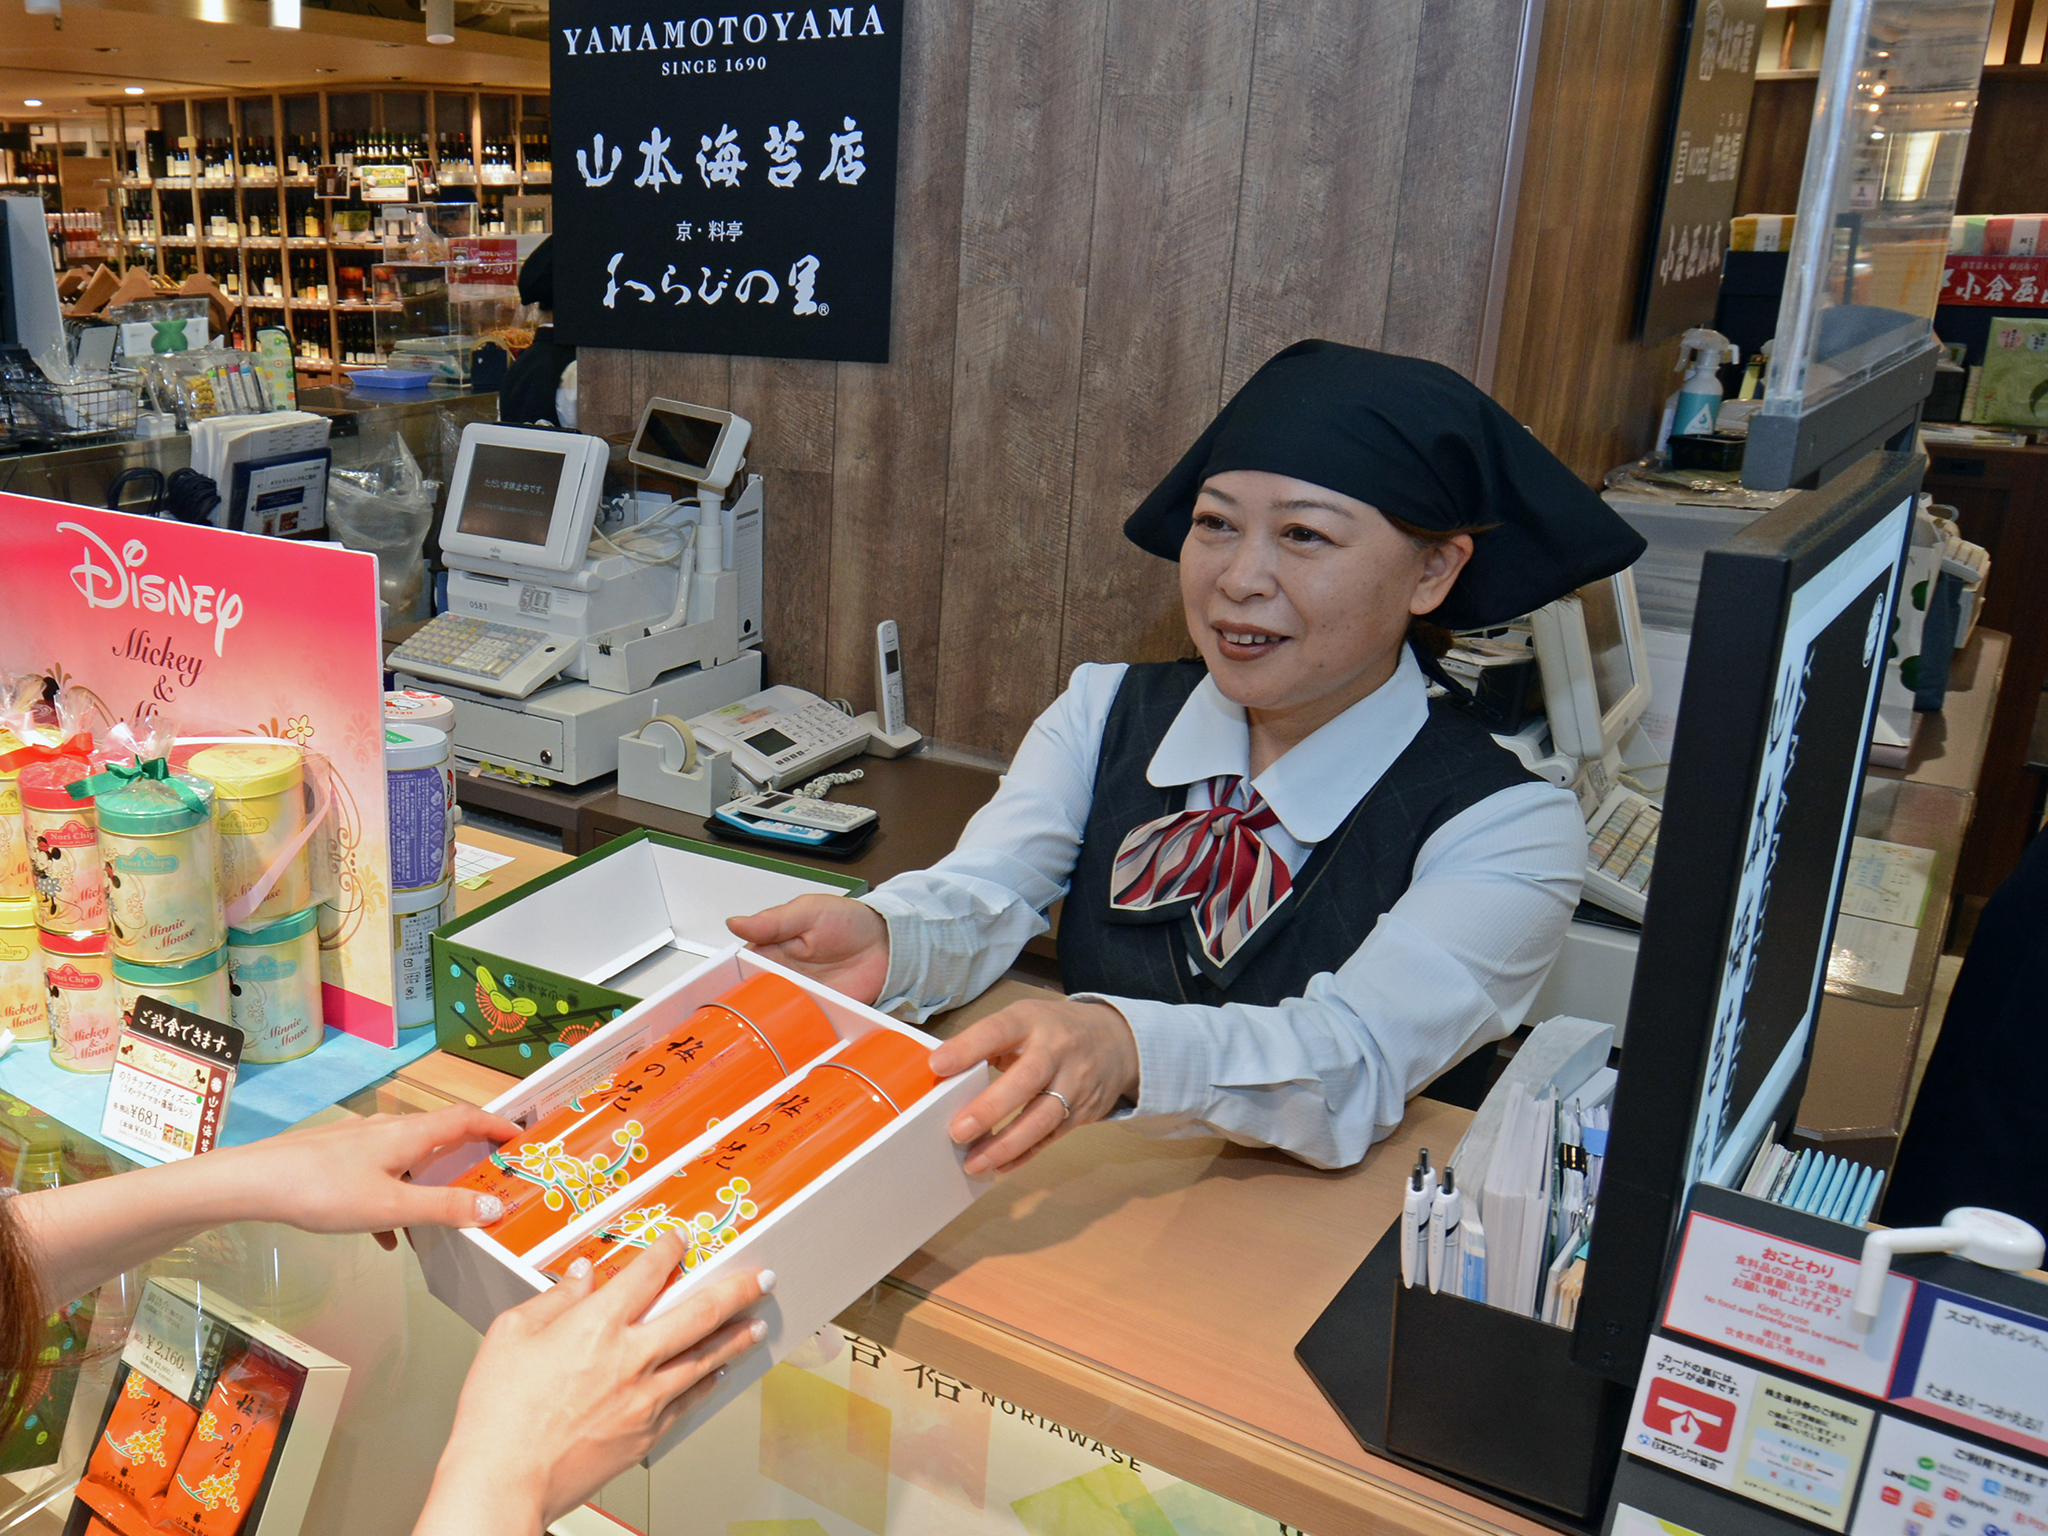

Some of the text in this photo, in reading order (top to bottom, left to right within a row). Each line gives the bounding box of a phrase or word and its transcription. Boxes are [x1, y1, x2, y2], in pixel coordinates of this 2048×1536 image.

[563, 4, 884, 55] YAMAMOTOYAMA
[661, 56, 767, 75] SINCE 1690
[576, 116, 866, 193] 山本海苔店
[676, 220, 743, 242] 京・料亭
[485, 479, 545, 495] ただいま休止中です。
[469, 600, 488, 611] 0583
[112, 627, 206, 688] Mickey
[153, 675, 176, 702] &
[73, 831, 96, 841] Chip
[121, 858, 171, 868] Nori Chips
[143, 918, 186, 939] Minnie
[155, 927, 196, 950] Mouse
[68, 974, 95, 985] Chips
[0, 1002, 39, 1018] Mickey
[7, 1013, 44, 1029] Mouse
[69, 1026, 110, 1043] Mickey
[139, 1009, 232, 1059] ご試食できます。
[263, 1018, 302, 1041] Minnie
[275, 1024, 310, 1050] Mouse
[75, 1043, 115, 1061] Minnie
[89, 1039, 100, 1048] &
[1762, 1247, 1835, 1279] おことわり
[1735, 1254, 1853, 1298] 食料品の返品・交換は
[1740, 1268, 1842, 1307] ご遠慮願いますよう
[1732, 1277, 1841, 1321] お願い申し上げます。
[1704, 1295, 1716, 1304] No
[1717, 1298, 1737, 1311] food
[1738, 1304, 1753, 1316] and
[1755, 1311, 1793, 1329] beverage
[1794, 1325, 1810, 1335] can
[1811, 1329, 1823, 1338] be
[1757, 1303, 1810, 1326] Kindly note
[1657, 1362, 1740, 1397] サインが必要です。
[1662, 1354, 1737, 1386] カードの裏には、
[981, 1388, 1143, 1474] NORIAWASE
[1651, 1441, 1718, 1471] 日本クレジット協会
